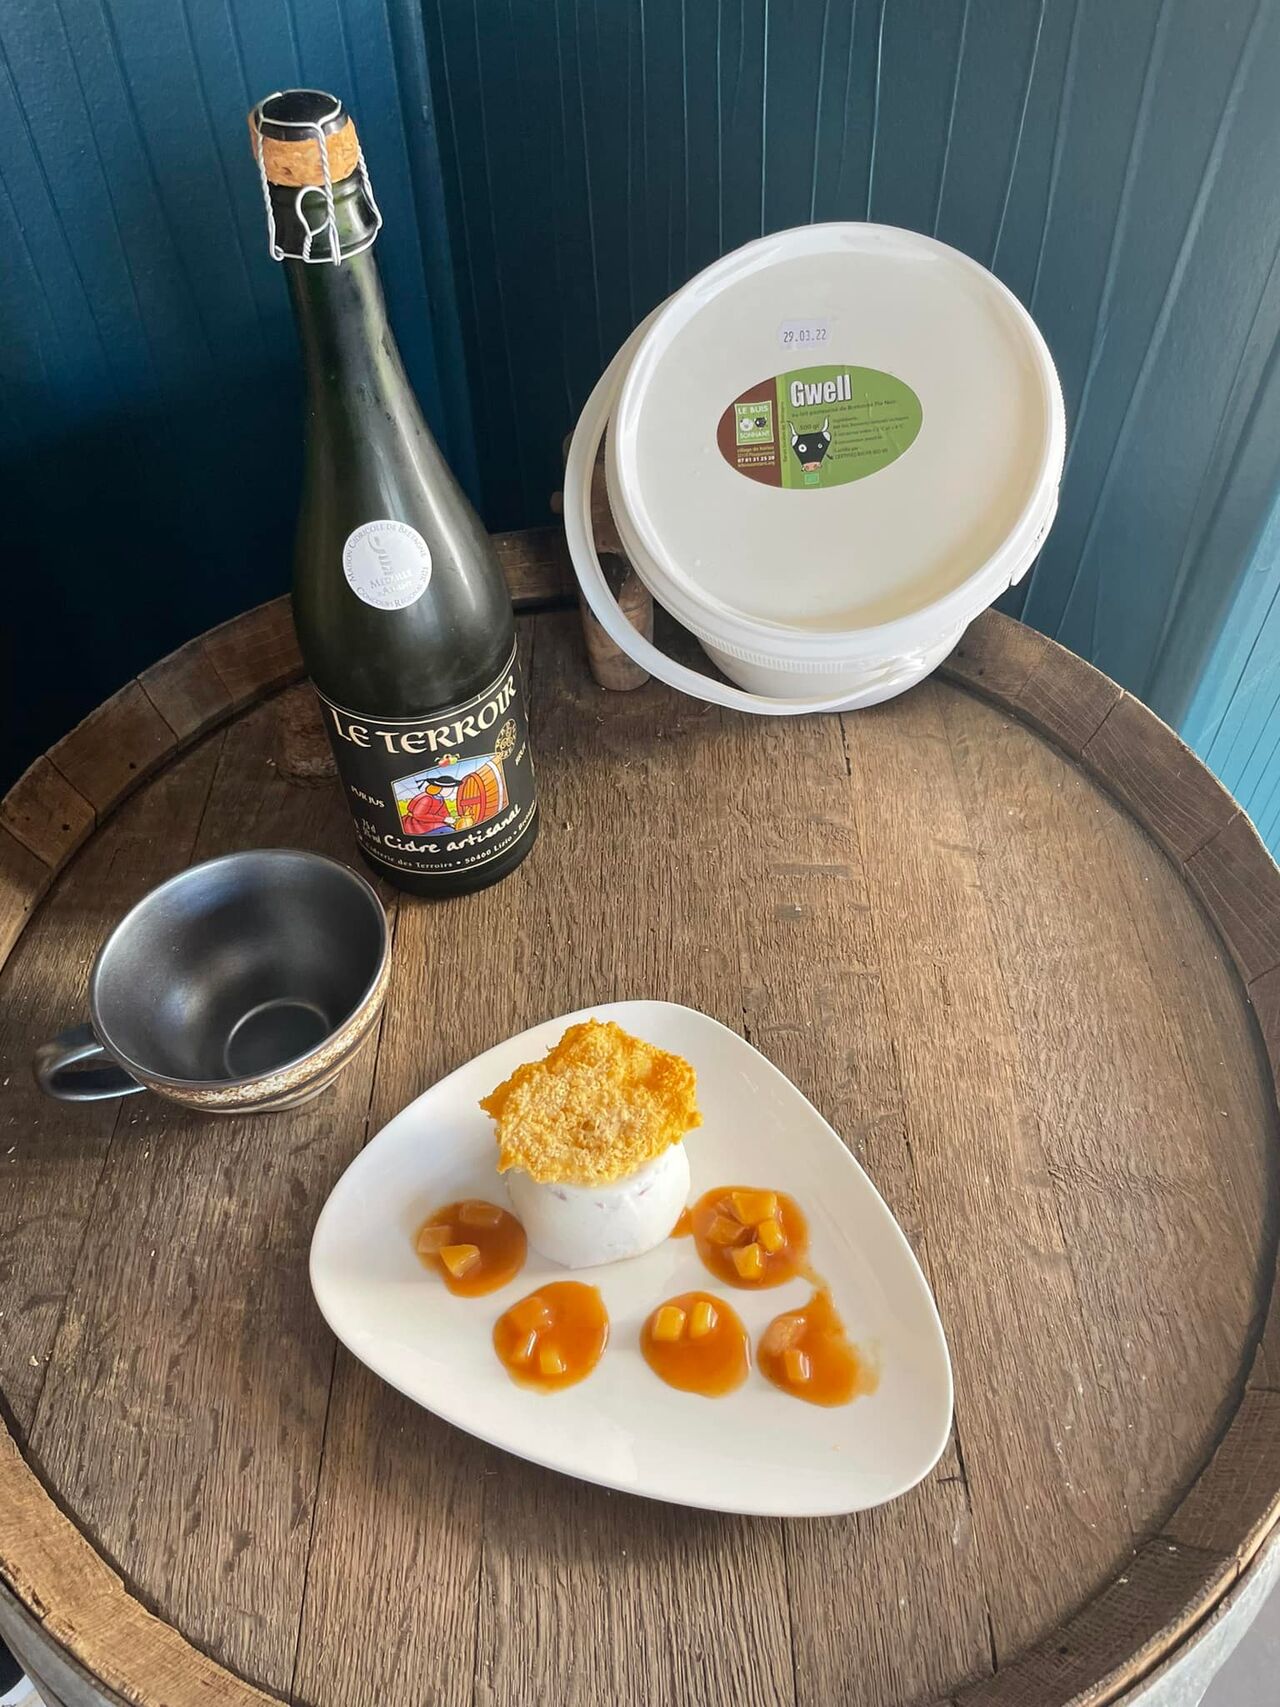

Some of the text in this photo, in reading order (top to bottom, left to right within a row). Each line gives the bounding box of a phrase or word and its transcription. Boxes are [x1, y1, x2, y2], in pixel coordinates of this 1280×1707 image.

[783, 328, 827, 343] 29.03.22
[790, 374, 853, 408] Gwell
[738, 404, 769, 415] LE BUIS
[330, 708, 372, 748] LE
[375, 675, 517, 754] TERROIR
[384, 833, 441, 854] Cidre
[446, 803, 522, 852] artisanal
[397, 858, 413, 867] des
[415, 860, 454, 870] Terroirs
